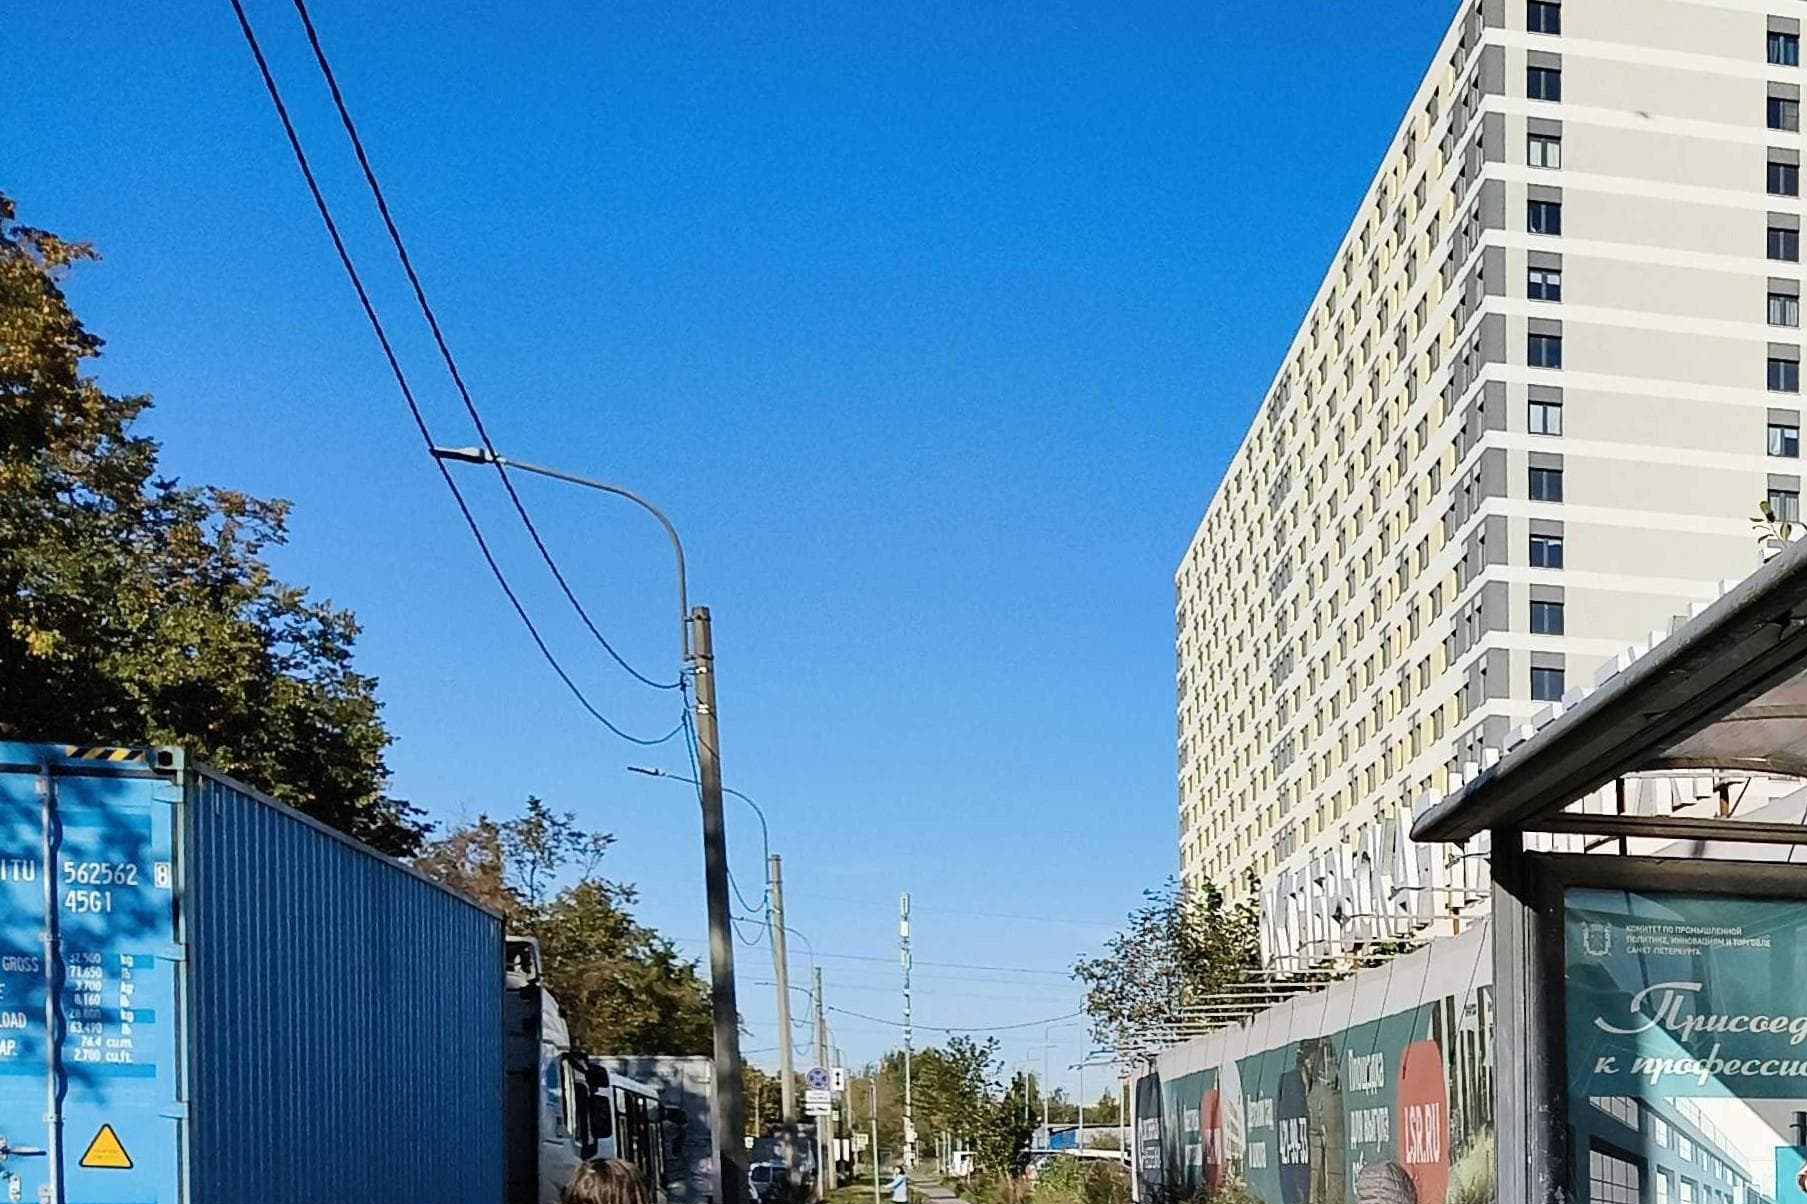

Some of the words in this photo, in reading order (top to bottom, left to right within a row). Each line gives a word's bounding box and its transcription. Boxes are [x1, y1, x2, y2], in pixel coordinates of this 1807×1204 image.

[63, 861, 139, 886] 562562
[64, 889, 112, 913] 45G1
[1625, 924, 1662, 935] КОМИТЕТ
[1663, 925, 1674, 935] ПО
[1675, 925, 1743, 937] ПРОМЫШЛЕННОЙ
[1671, 936, 1725, 947] ИННОВАЦИЯМ
[1733, 937, 1772, 948] ТОРГОВЛЕ
[2, 956, 40, 973] GROSS
[120, 953, 135, 968] kg
[0, 1012, 27, 1029] OAD
[1594, 1055, 1619, 1075] к
[1404, 1102, 1441, 1164] LSR.RU
